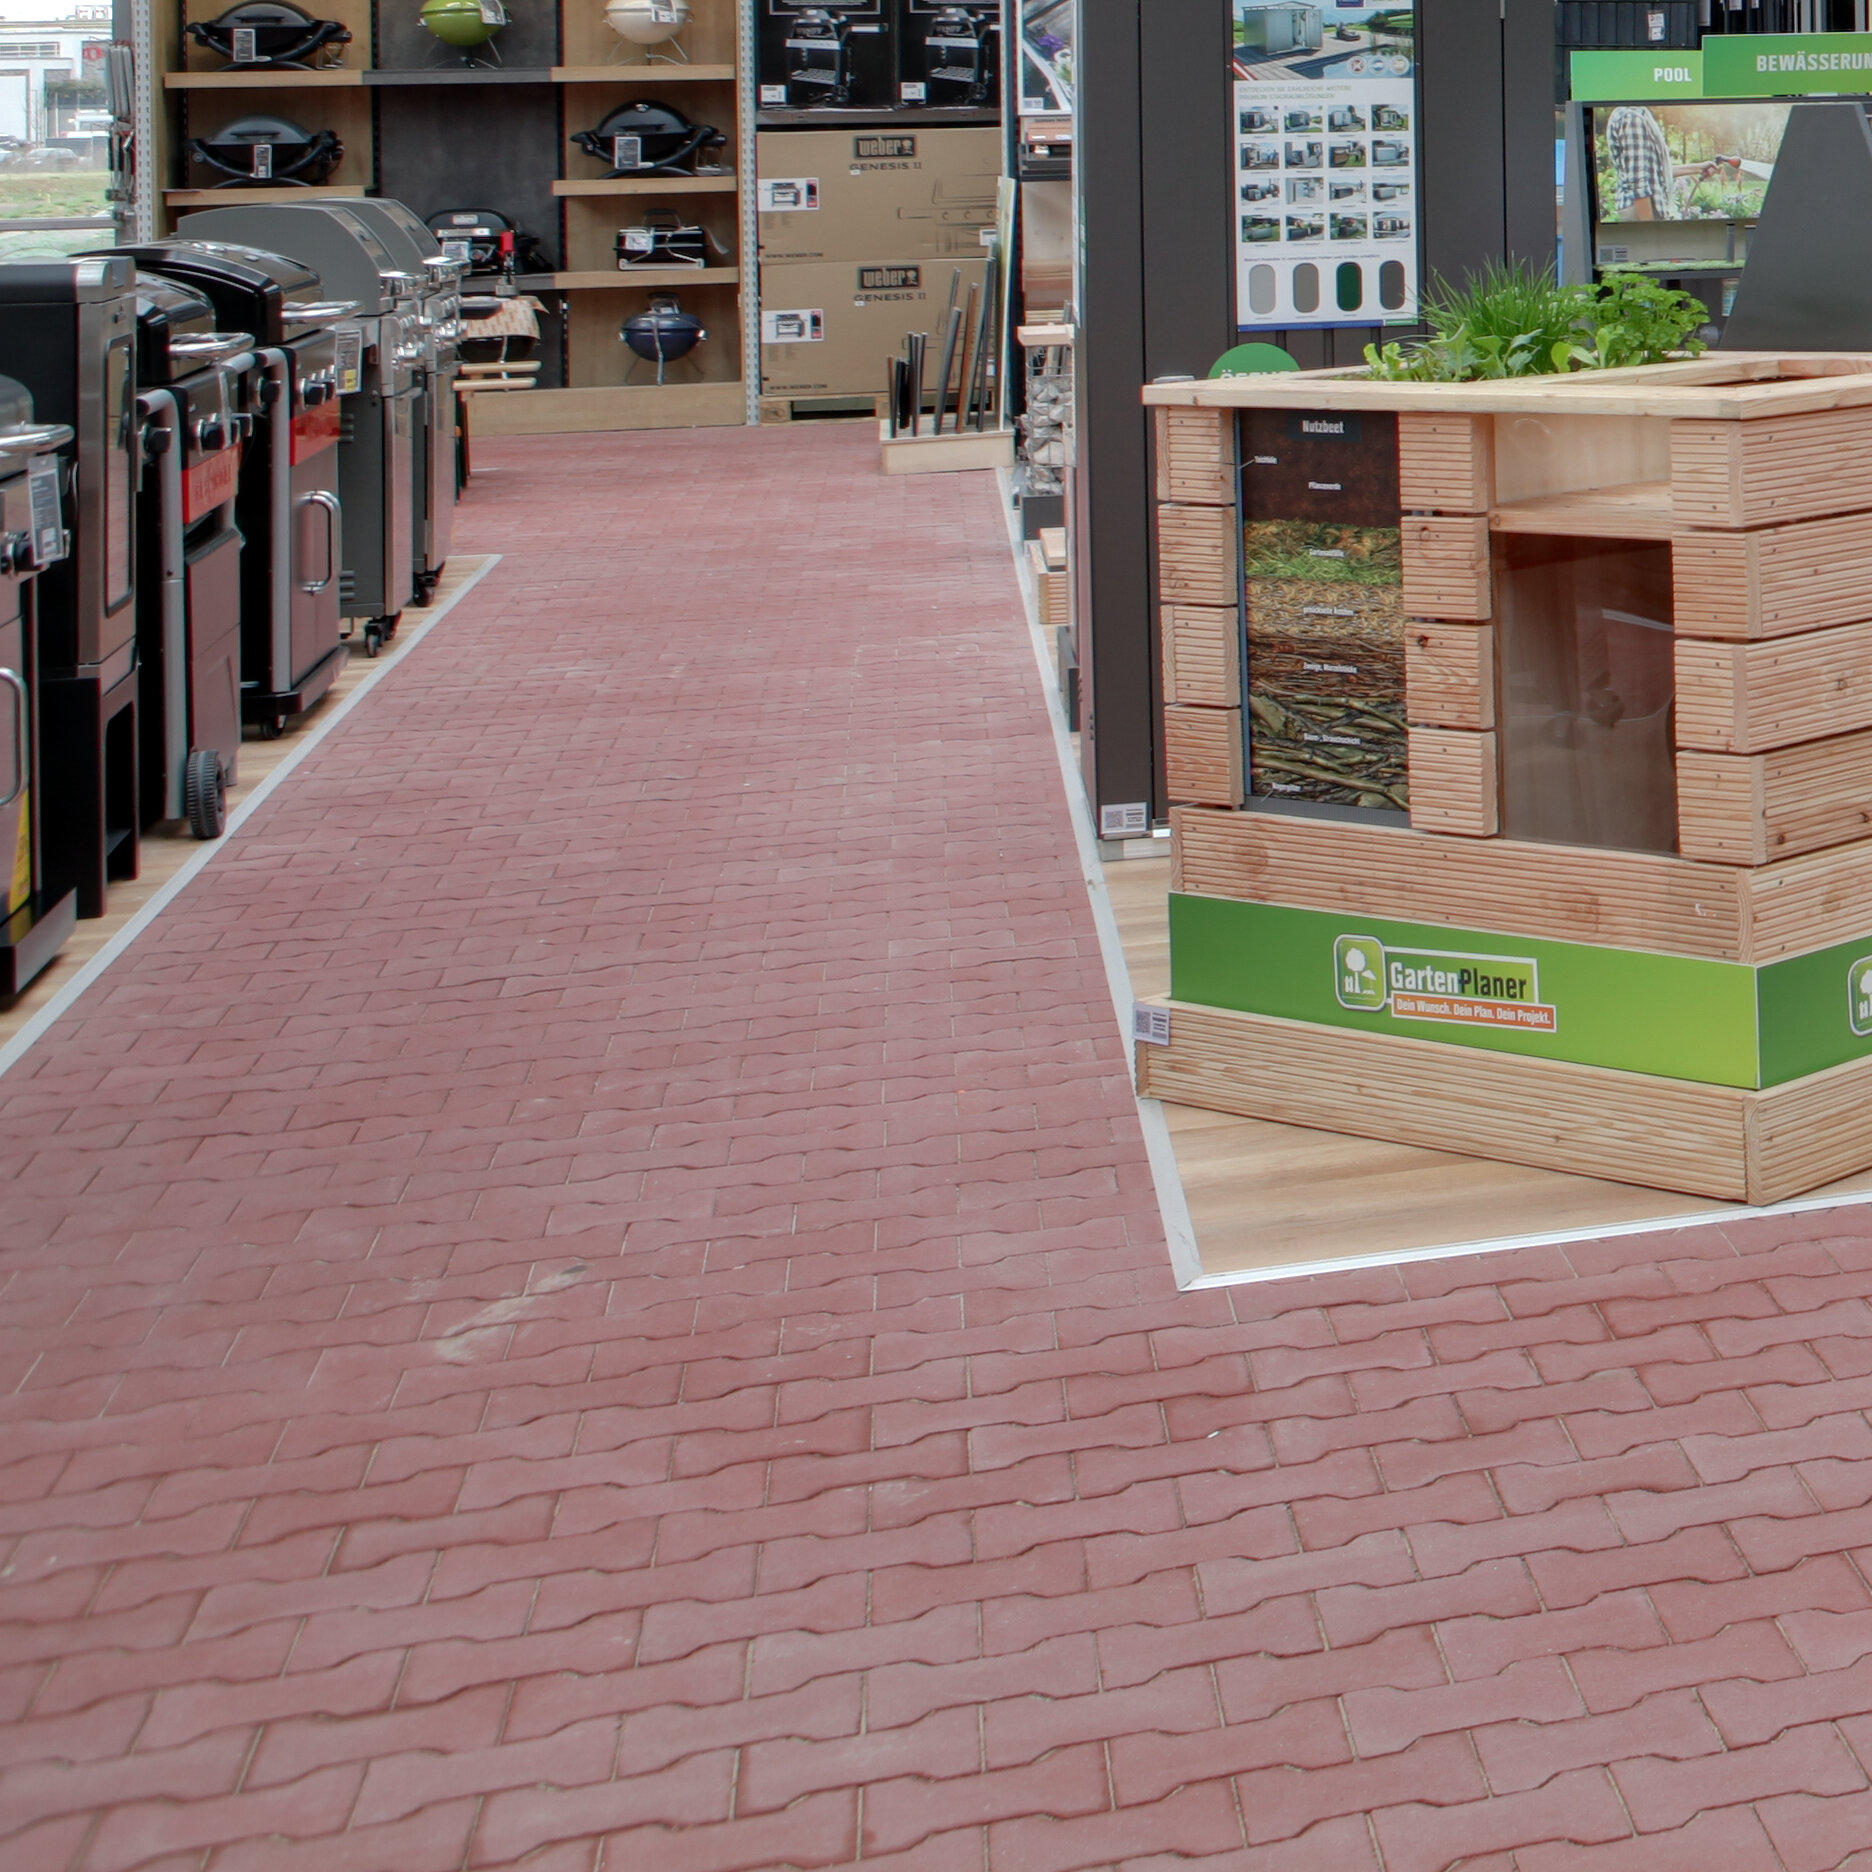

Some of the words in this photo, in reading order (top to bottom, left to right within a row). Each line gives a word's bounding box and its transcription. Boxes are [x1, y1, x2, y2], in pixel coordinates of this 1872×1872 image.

[1653, 66, 1692, 83] POOL
[859, 136, 901, 157] weber
[850, 162, 910, 171] GENESIS
[862, 267, 906, 290] weber
[854, 293, 914, 302] GENESIS
[1302, 419, 1345, 434] Nutzbeet
[1390, 961, 1527, 1000] GartenPlaner
[1397, 998, 1416, 1011] Dein
[1417, 1000, 1451, 1015] Wunsch.
[1453, 1003, 1472, 1017] Dein
[1474, 1005, 1495, 1019] Plan.
[1496, 1007, 1516, 1021] Dein
[1517, 1009, 1552, 1026] Projekt.
